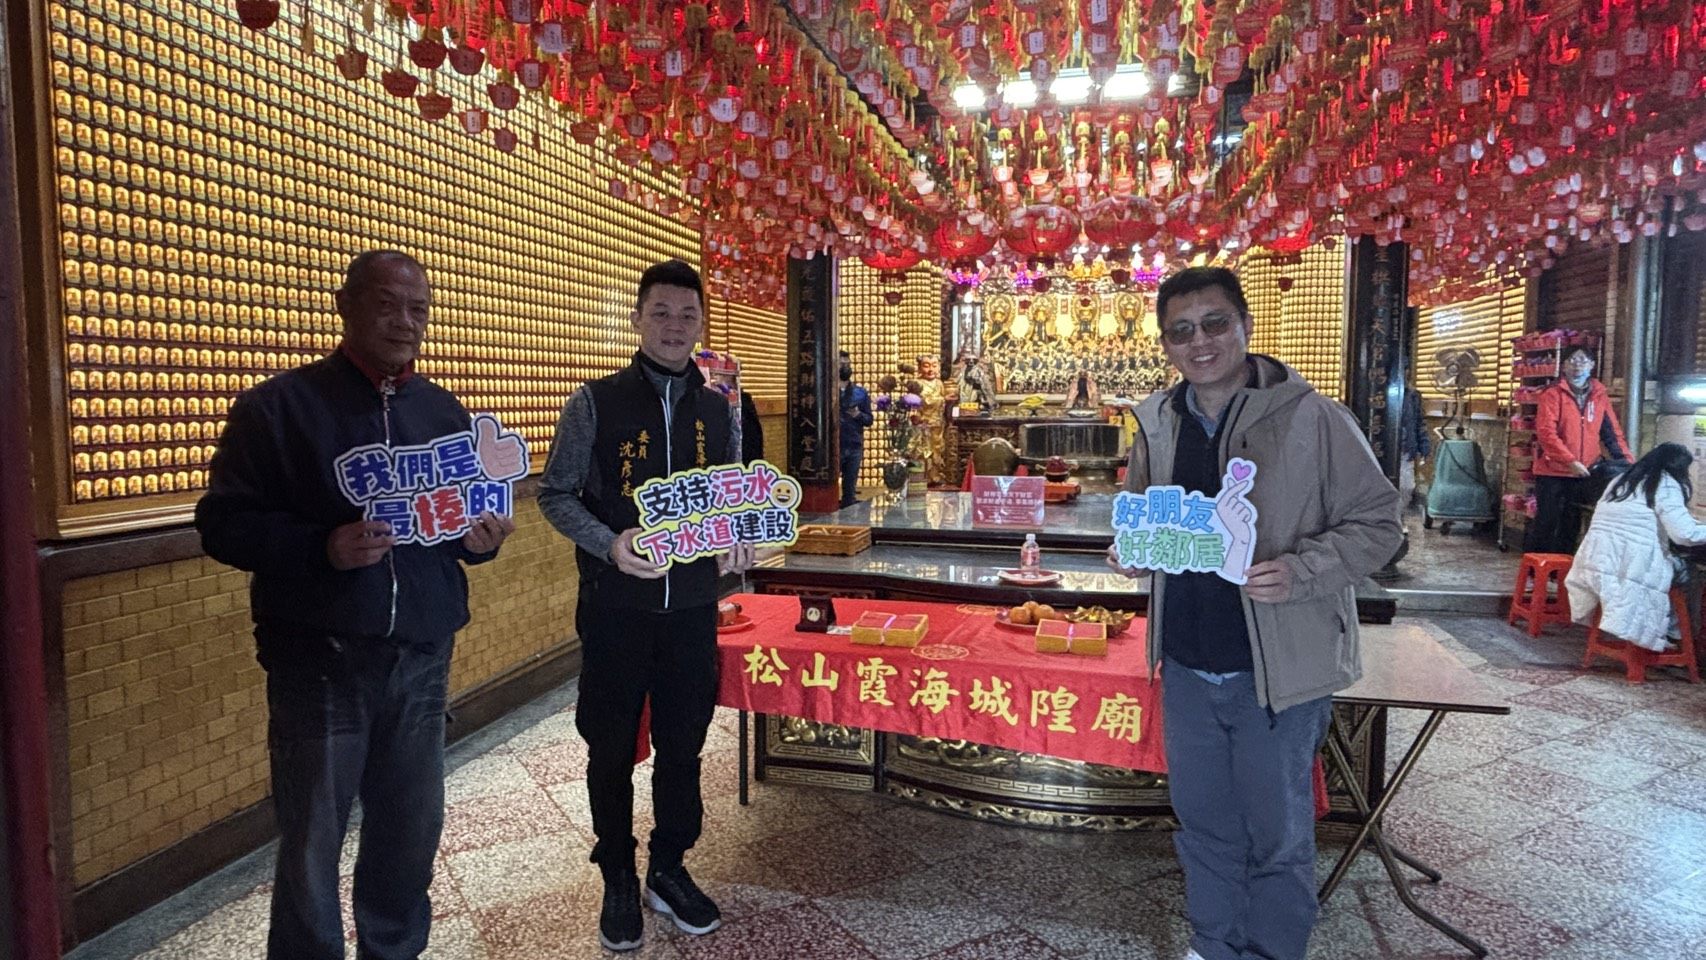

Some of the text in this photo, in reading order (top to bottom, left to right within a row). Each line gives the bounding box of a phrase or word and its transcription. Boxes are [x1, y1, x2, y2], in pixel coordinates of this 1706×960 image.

[342, 435, 479, 497] 我們是
[638, 430, 650, 459] 委員
[369, 480, 511, 539] 最棒的
[643, 467, 775, 521] 支持污水
[1116, 489, 1218, 533] 好朋友
[640, 513, 792, 565] 下水道建設
[1119, 528, 1226, 570] 好鄰居
[743, 644, 1143, 744] 松山霞海城隍廟
